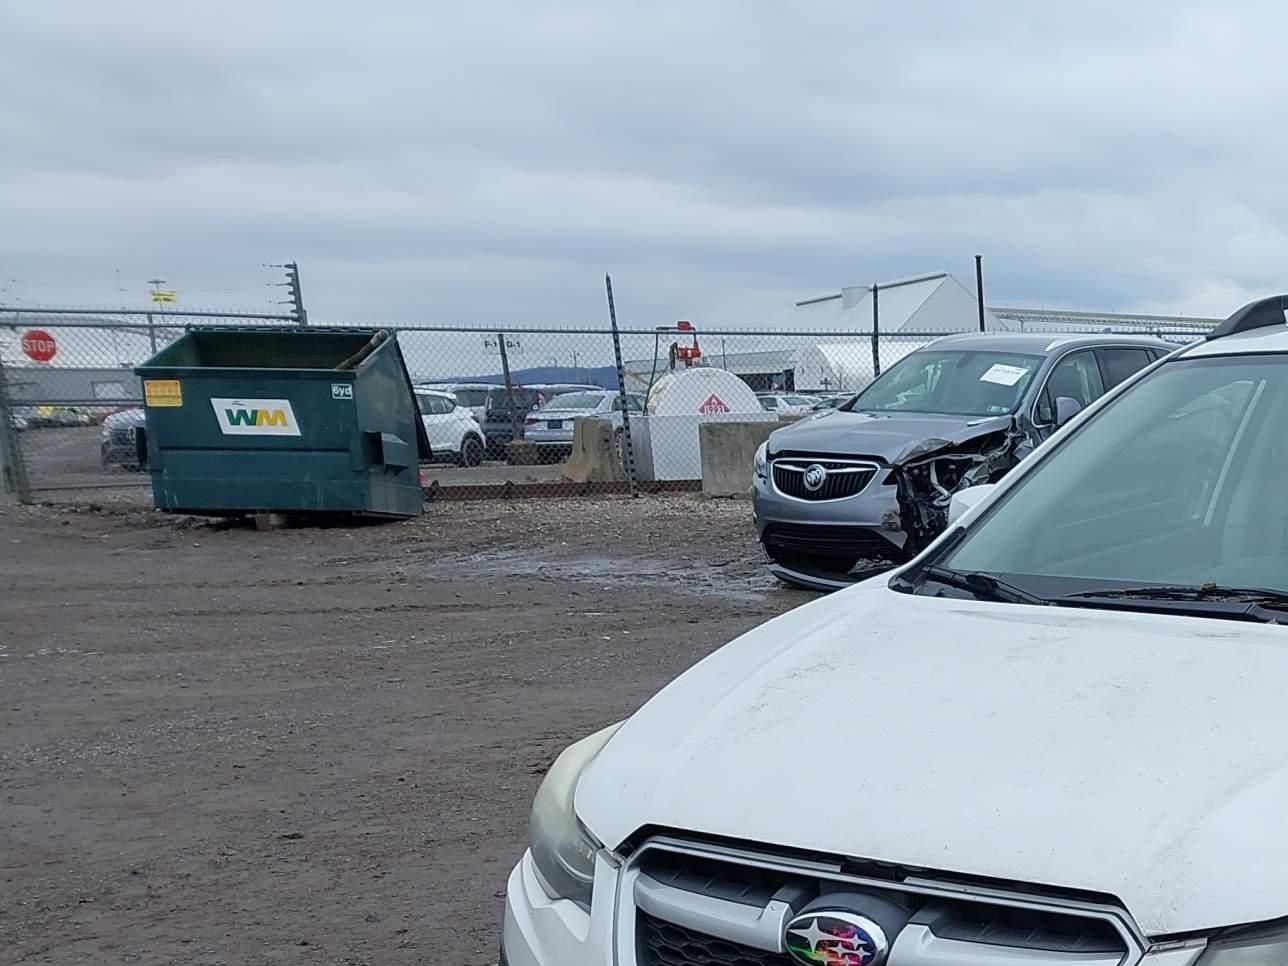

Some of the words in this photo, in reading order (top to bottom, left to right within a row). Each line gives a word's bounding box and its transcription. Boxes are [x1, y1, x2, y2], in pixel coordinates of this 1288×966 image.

[23, 339, 55, 352] STOP
[332, 385, 352, 397] 6yd
[225, 408, 289, 427] WM
